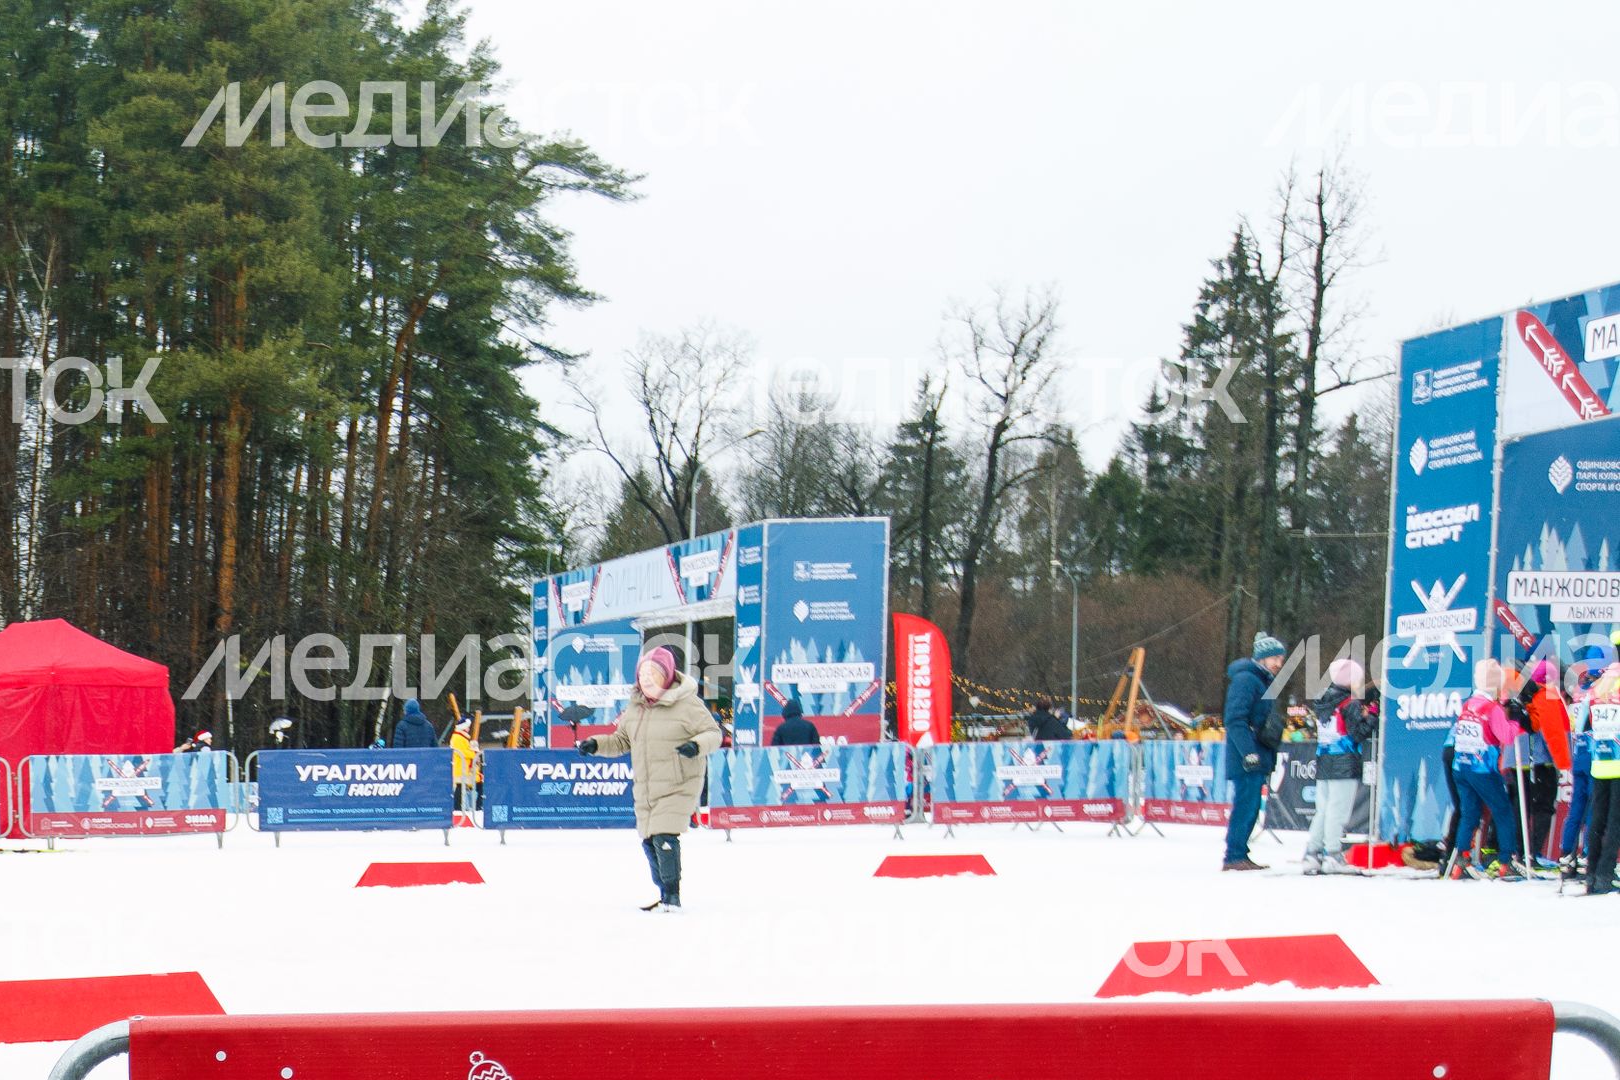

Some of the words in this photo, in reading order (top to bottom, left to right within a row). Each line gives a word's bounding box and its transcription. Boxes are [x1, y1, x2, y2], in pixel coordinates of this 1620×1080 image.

[1567, 606, 1614, 619] ЛЫЖНЯ
[1397, 692, 1462, 720] ЗИМА
[295, 763, 417, 782] УРАЛХИМ
[1291, 760, 1317, 780] Поб
[314, 783, 346, 797] SKI
[348, 783, 404, 797] FACTORY
[538, 782, 571, 796] SKI
[572, 782, 628, 796] FACTORY
